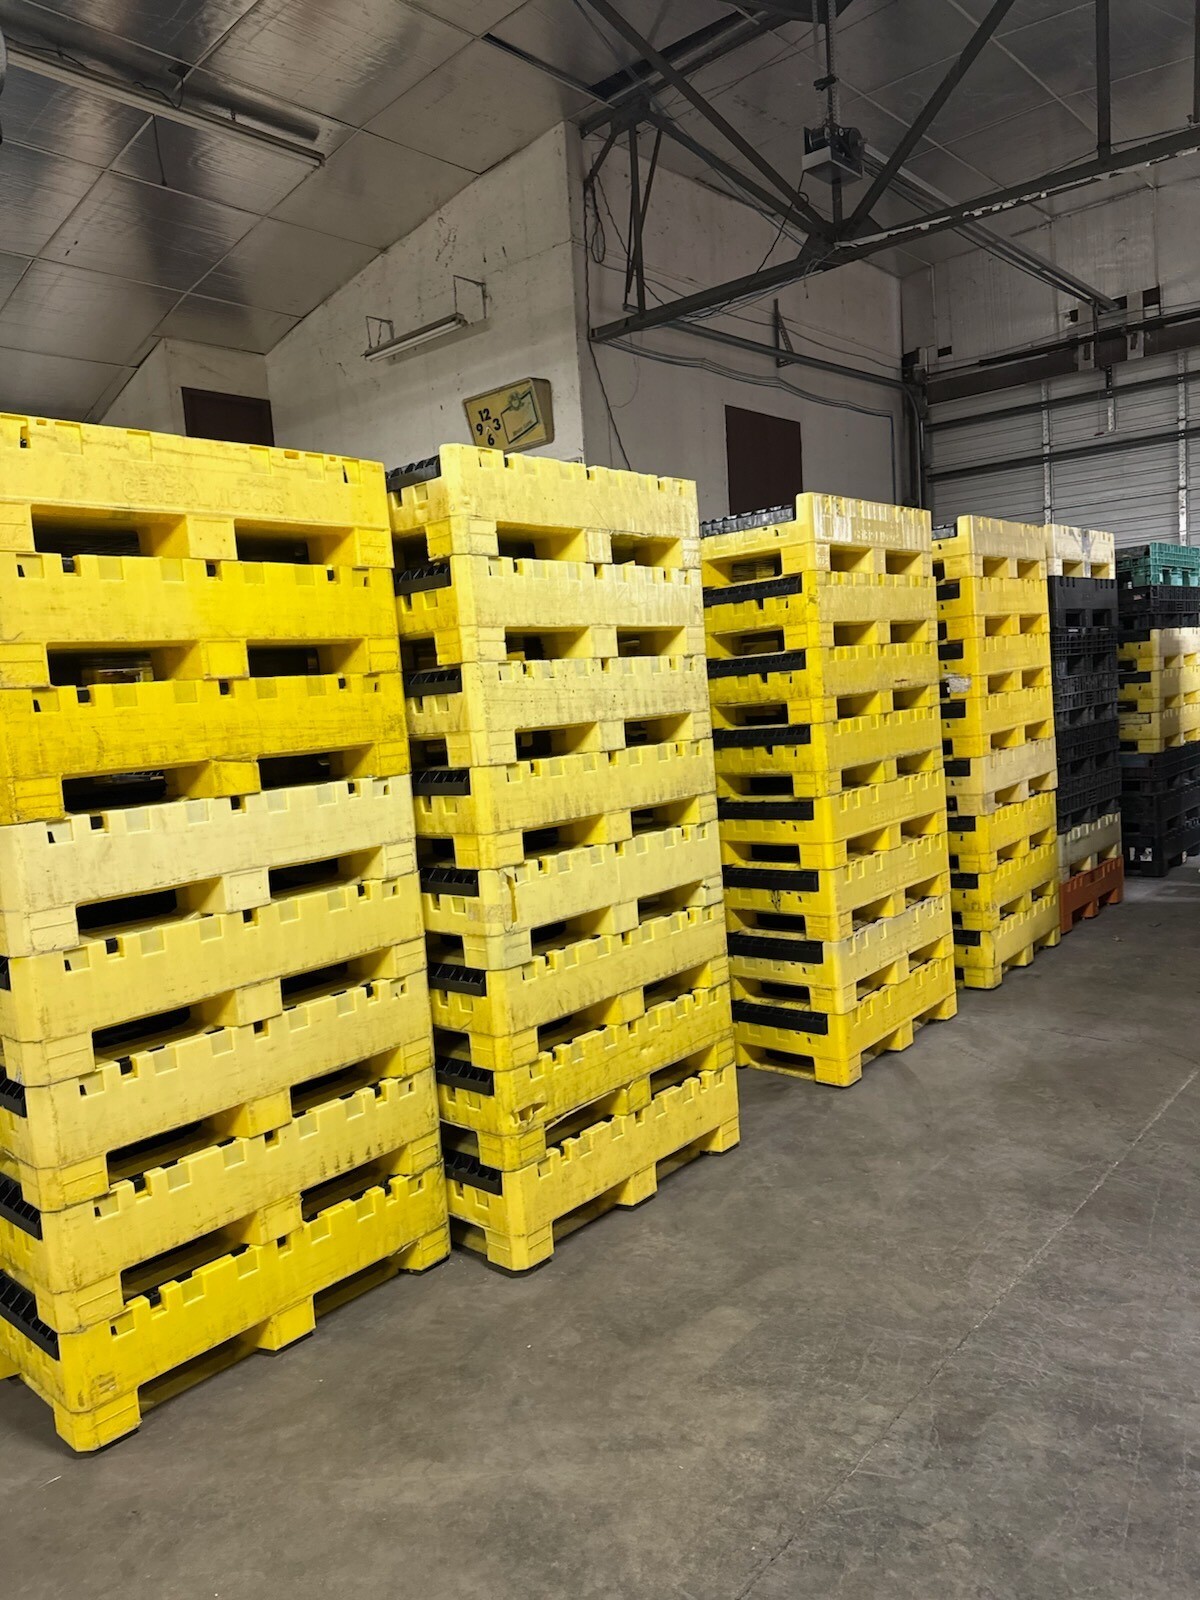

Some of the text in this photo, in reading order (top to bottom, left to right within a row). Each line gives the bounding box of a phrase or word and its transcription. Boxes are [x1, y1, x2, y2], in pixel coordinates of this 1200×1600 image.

[478, 408, 491, 422] 12
[476, 423, 483, 436] 9
[492, 418, 501, 431] 3
[487, 434, 495, 446] 6
